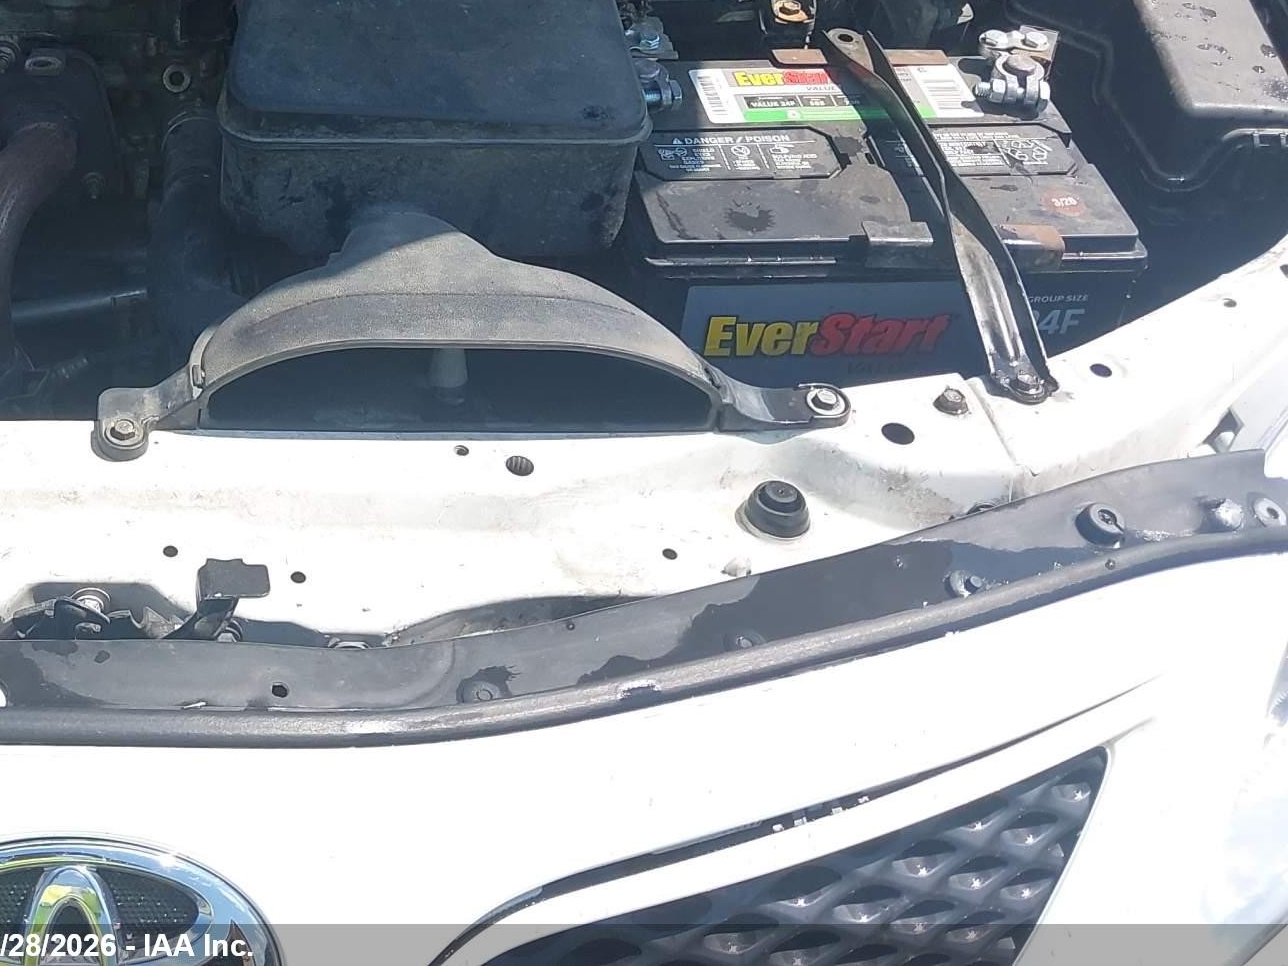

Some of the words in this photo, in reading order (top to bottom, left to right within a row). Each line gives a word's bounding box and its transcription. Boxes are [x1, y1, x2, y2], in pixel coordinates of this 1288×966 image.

[684, 136, 734, 145] DANGER
[745, 134, 791, 143] POISON
[1065, 294, 1089, 302] SIZE
[703, 312, 952, 359] EverStart
